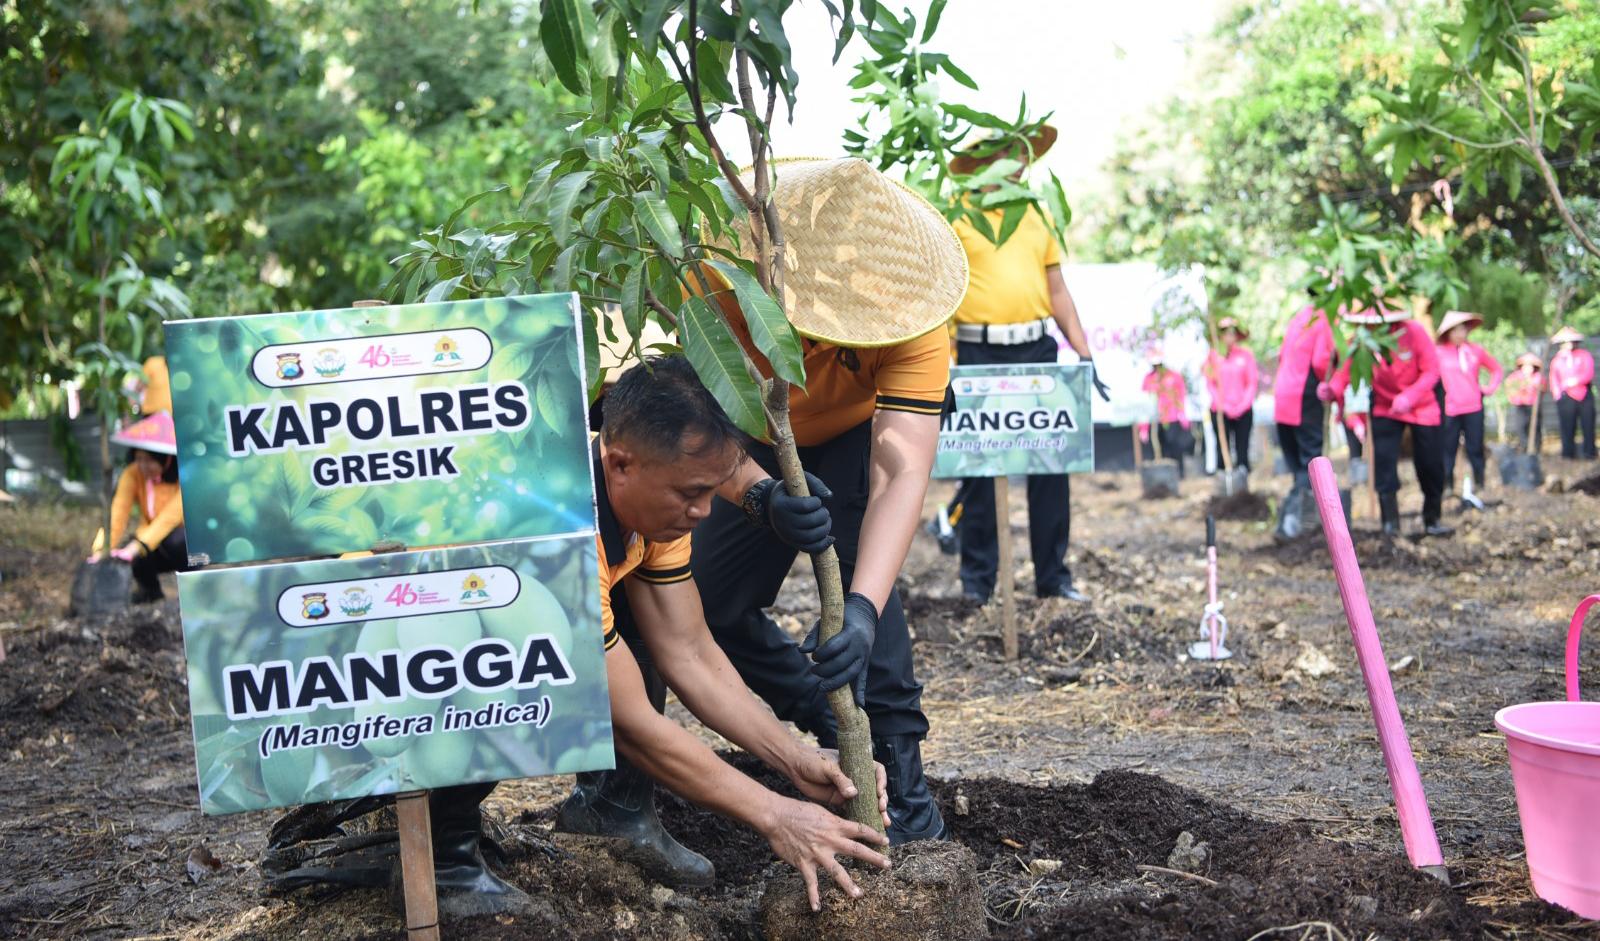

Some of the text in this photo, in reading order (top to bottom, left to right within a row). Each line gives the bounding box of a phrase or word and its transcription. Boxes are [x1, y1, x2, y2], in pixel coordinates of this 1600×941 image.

[357, 344, 391, 369] 46
[228, 385, 528, 452] KAPOLRES
[312, 445, 459, 487] GRESIK
[384, 582, 418, 608] 46
[228, 637, 570, 715] MANGGA
[259, 697, 553, 757] (Mangifera indica)
